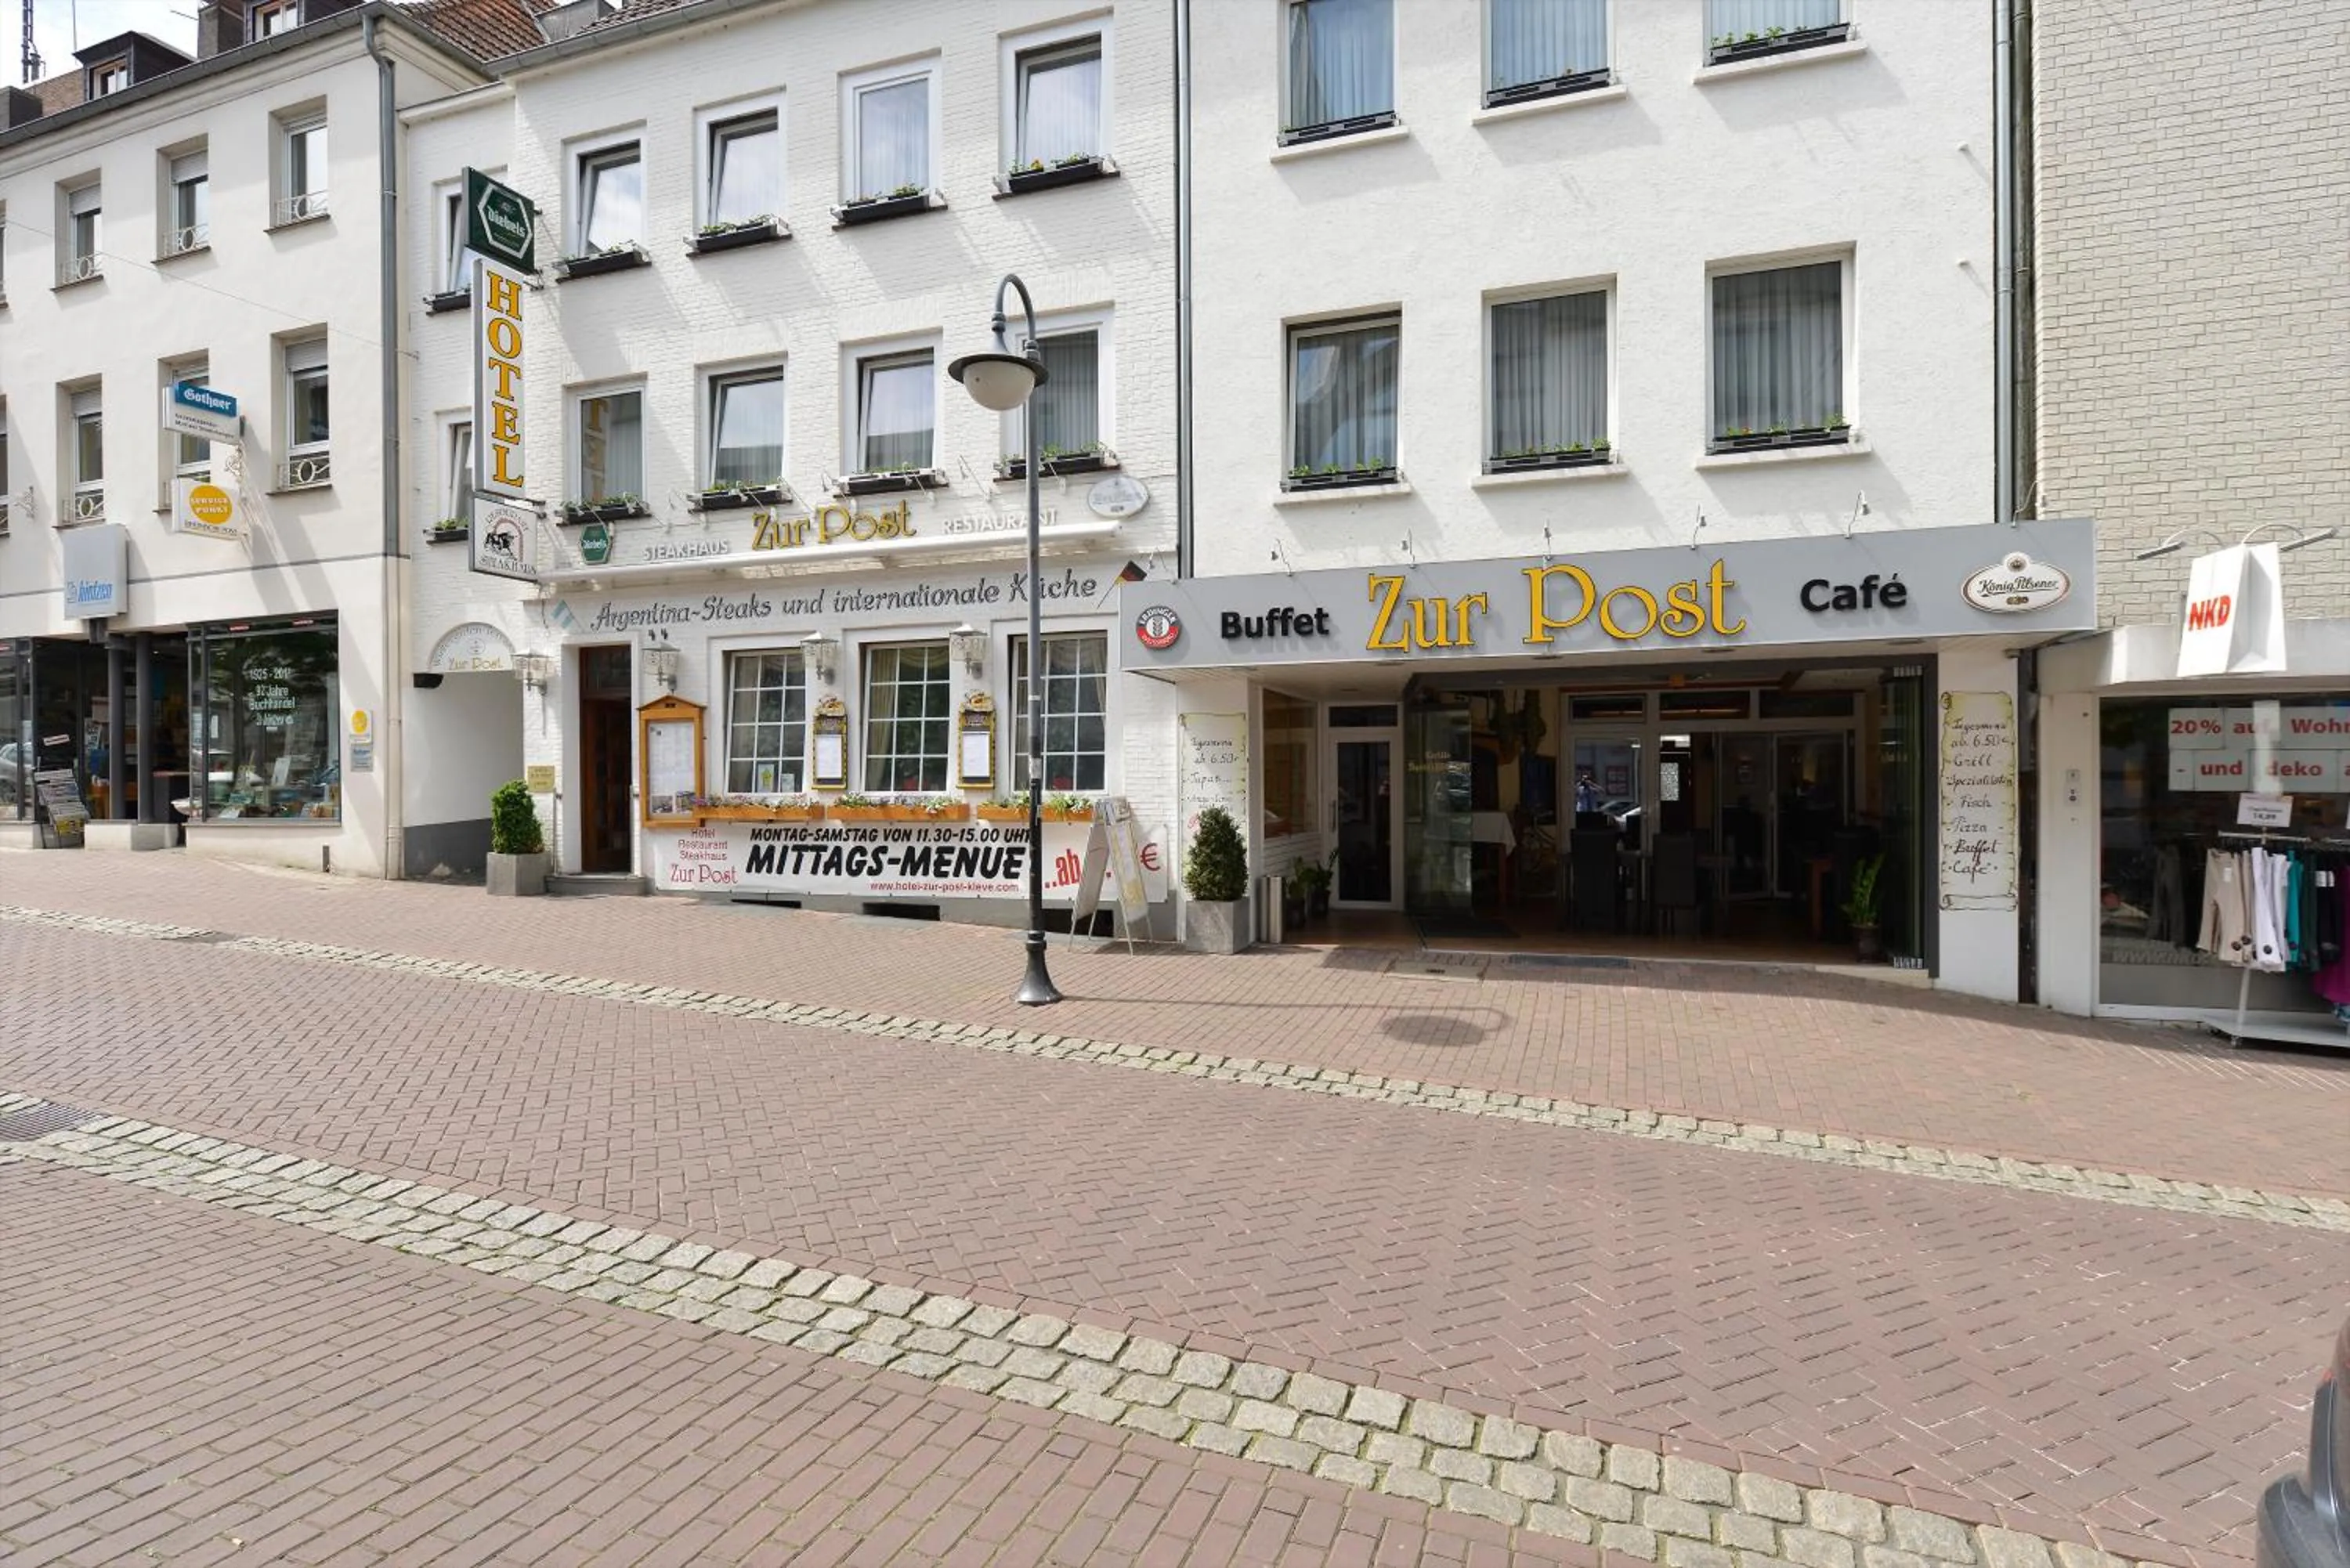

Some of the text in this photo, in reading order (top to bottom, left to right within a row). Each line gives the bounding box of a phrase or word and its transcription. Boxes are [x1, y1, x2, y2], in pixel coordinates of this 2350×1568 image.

[486, 269, 523, 488] HOTEL
[184, 388, 231, 413] Gothaer
[642, 538, 728, 562] STEAKHAUS
[751, 512, 810, 551] Zur
[817, 499, 917, 544] Post
[590, 592, 772, 632] Argentina-Steaks
[783, 588, 825, 615] und
[833, 577, 1000, 613] internationale
[1365, 558, 1747, 653] Zur Post
[1800, 573, 1907, 612] Café
[1220, 607, 1330, 639] Buffet
[2189, 594, 2231, 631] NKD
[2171, 719, 2222, 735] 20%
[2200, 760, 2243, 776] und
[678, 839, 728, 850] Restaurant
[692, 829, 715, 839] Hotel
[750, 827, 878, 843] MONTAG-SAMSTAG
[883, 828, 913, 842] VON
[916, 828, 1000, 842] 11.30-15.00
[679, 850, 728, 861] Steakhaus
[746, 844, 1027, 879] MITTAGS-MENUE
[671, 863, 739, 884] Zur Post
